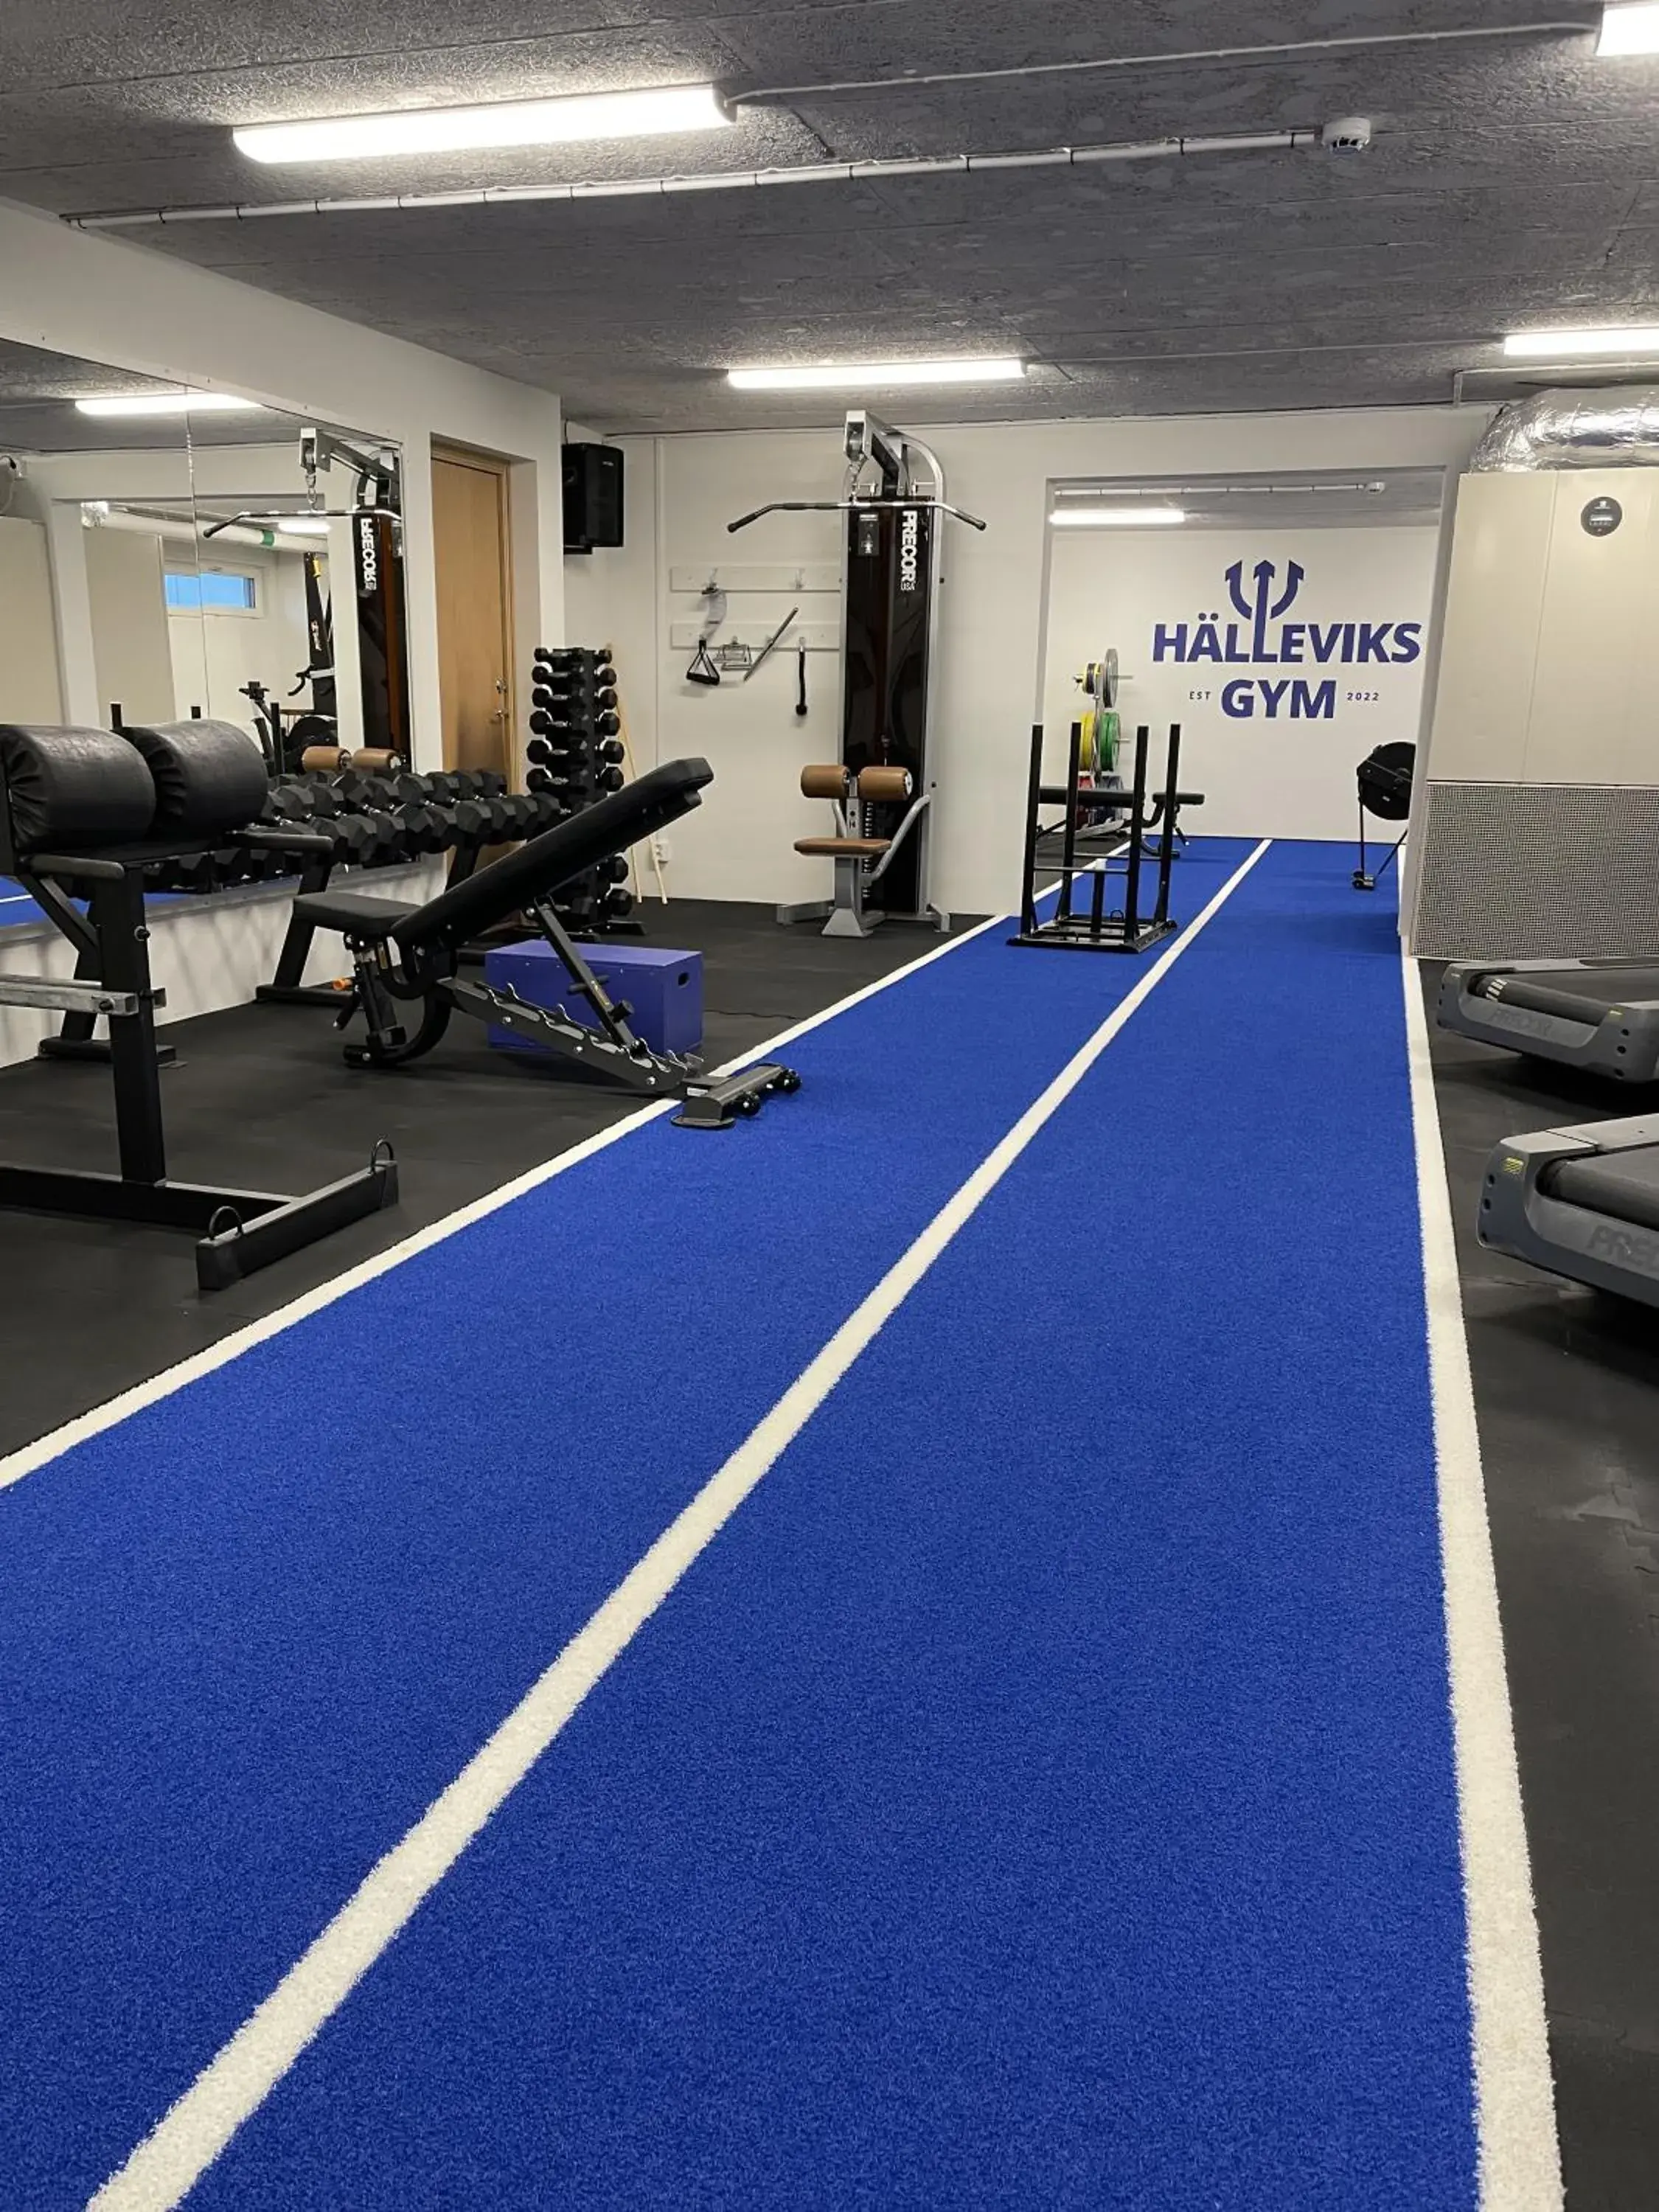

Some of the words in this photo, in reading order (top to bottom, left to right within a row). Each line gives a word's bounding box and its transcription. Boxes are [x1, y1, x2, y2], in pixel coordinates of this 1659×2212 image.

[900, 510, 917, 582] PRECOR
[1152, 613, 1422, 663] HÄLLEVIKS
[1189, 691, 1211, 700] EST
[1221, 679, 1337, 719] GYM
[1346, 692, 1380, 701] 2022
